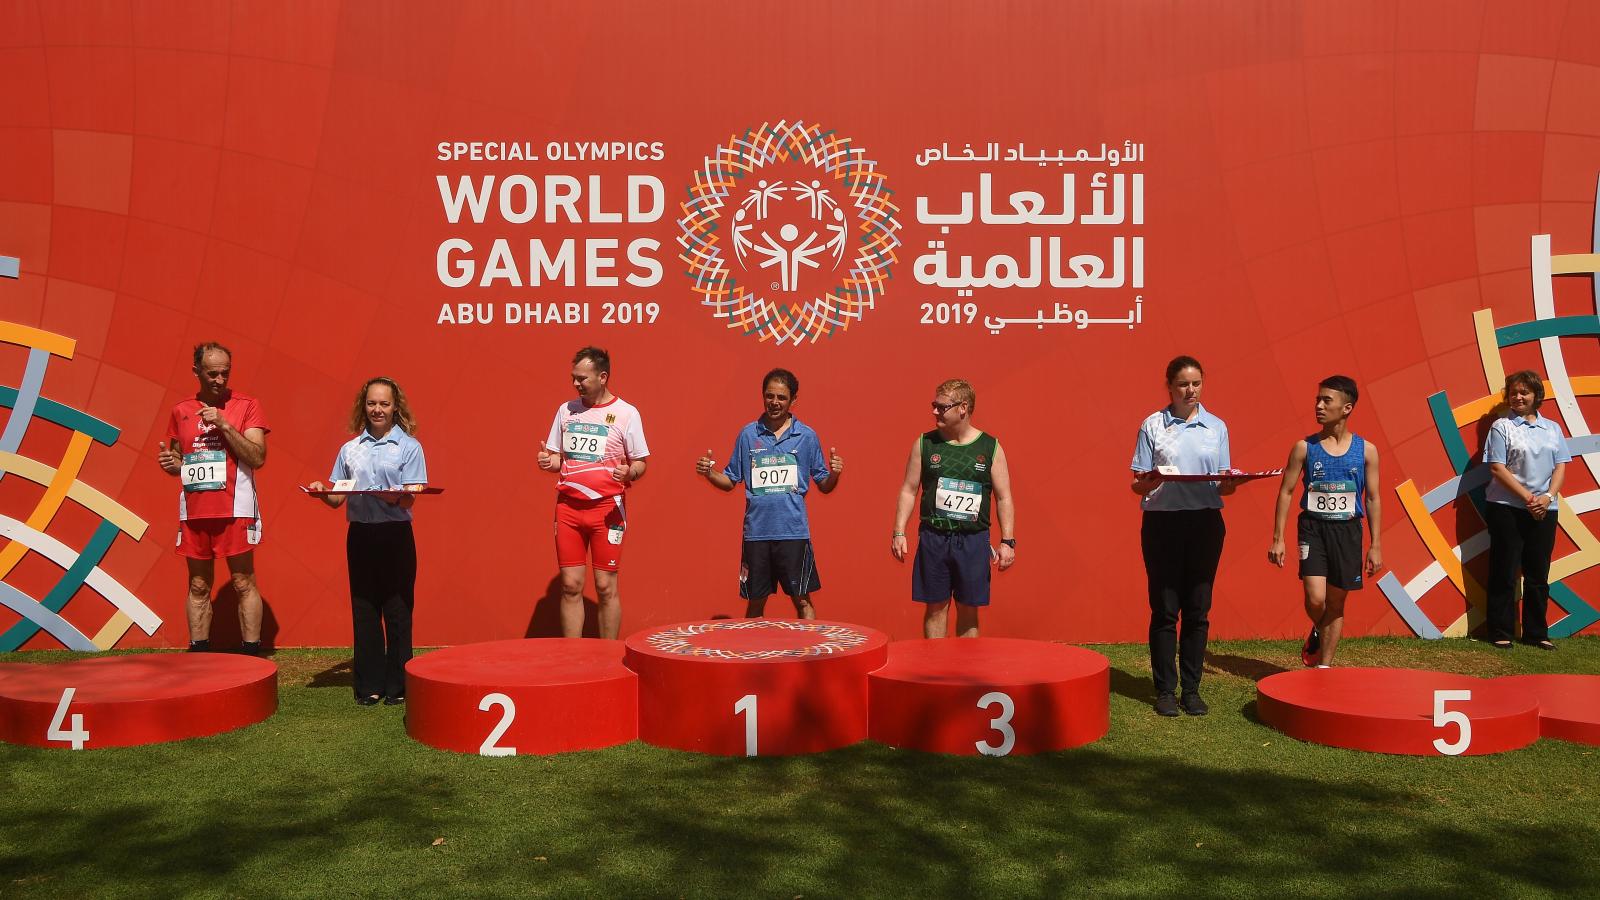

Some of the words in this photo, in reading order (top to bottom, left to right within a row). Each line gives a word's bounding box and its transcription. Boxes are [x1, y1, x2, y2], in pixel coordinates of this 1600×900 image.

[437, 141, 539, 161] SPECIAL
[546, 141, 665, 161] OLYMPICS
[915, 142, 999, 167] الخاص
[1003, 139, 1144, 167] الأولمبياد
[436, 174, 665, 224] WORLD
[916, 172, 1144, 234] الألعاب
[436, 237, 664, 288] GAMES
[913, 236, 1145, 297] العالمية
[436, 302, 494, 324] ABU
[505, 302, 590, 324] DHABI
[601, 302, 660, 324] 2019
[920, 302, 978, 325] 2019
[569, 436, 598, 453] 378
[188, 466, 215, 482] 901
[759, 469, 789, 485] 907
[943, 494, 974, 512] 472
[1316, 496, 1347, 511] 833
[47, 687, 90, 751] 4
[478, 692, 517, 757] 2
[733, 694, 758, 757] 1
[975, 691, 1016, 757] 3
[1432, 689, 1472, 756] 5
